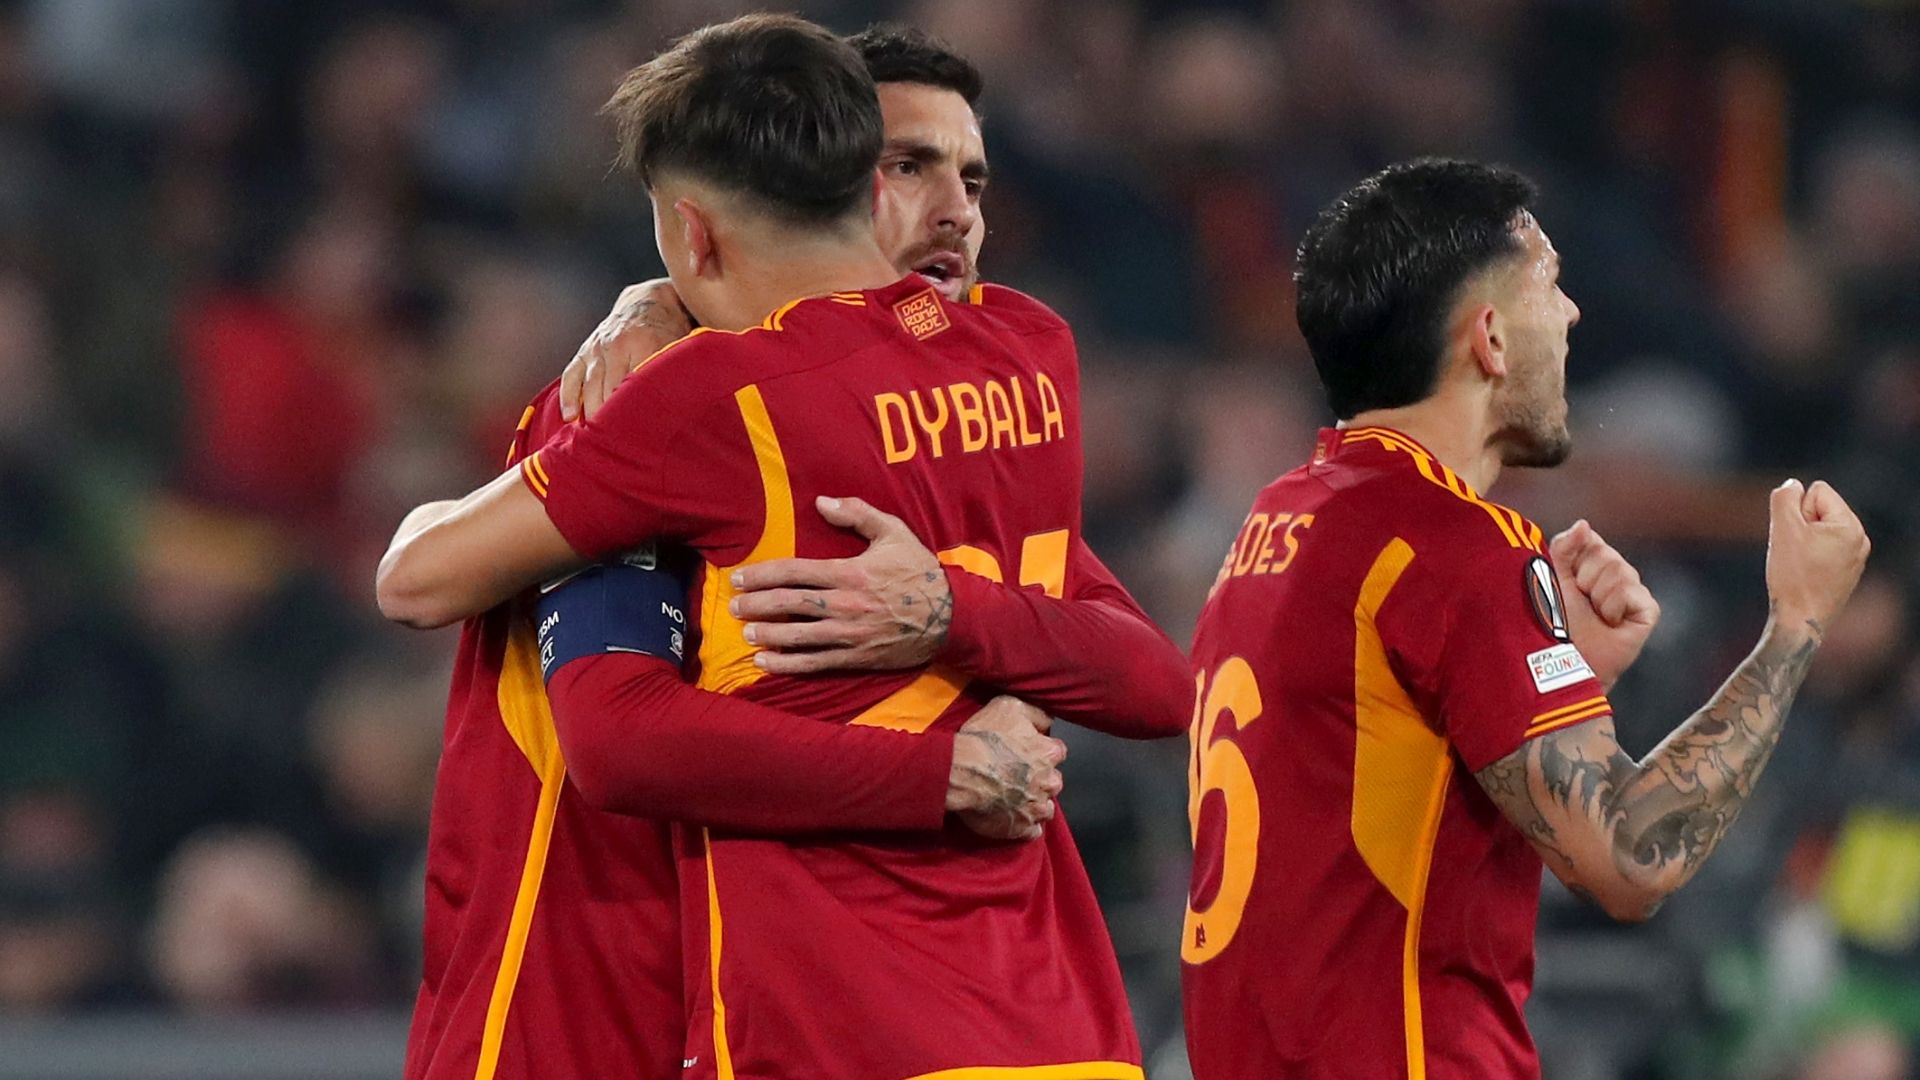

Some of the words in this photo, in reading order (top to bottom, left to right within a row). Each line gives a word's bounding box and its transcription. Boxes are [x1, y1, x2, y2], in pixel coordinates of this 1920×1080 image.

[902, 295, 931, 316] DAJE
[904, 304, 938, 327] ROMA
[911, 315, 942, 336] DAJE
[875, 371, 1064, 464] DYBALA
[1207, 512, 1315, 601] EDES
[661, 601, 683, 623] NO
